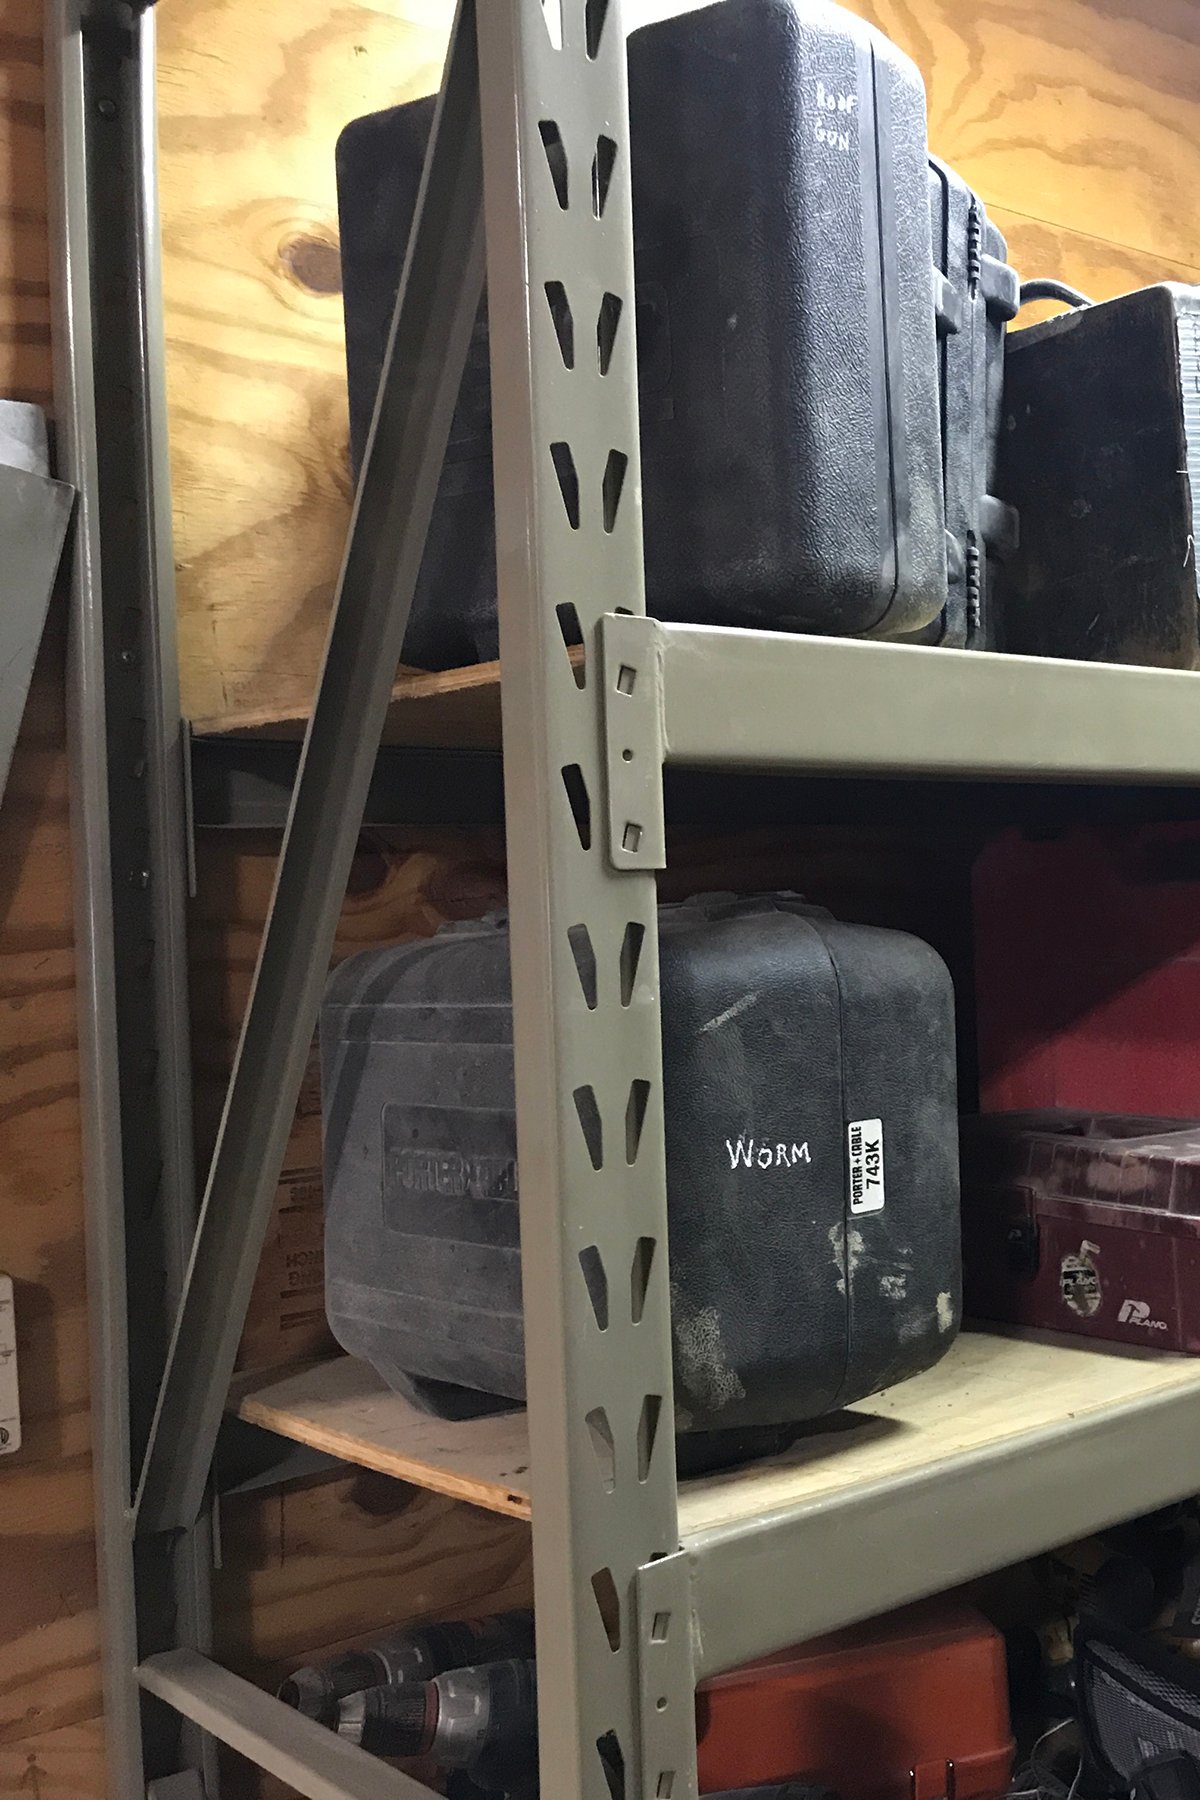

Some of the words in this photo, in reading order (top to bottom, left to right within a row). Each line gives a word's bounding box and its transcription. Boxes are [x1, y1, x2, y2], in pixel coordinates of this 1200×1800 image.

[815, 118, 850, 151] GUN
[725, 1138, 812, 1170] WORM
[864, 1139, 881, 1190] 743K
[852, 1168, 864, 1205] PORTER
[1128, 1317, 1168, 1331] PLANO
